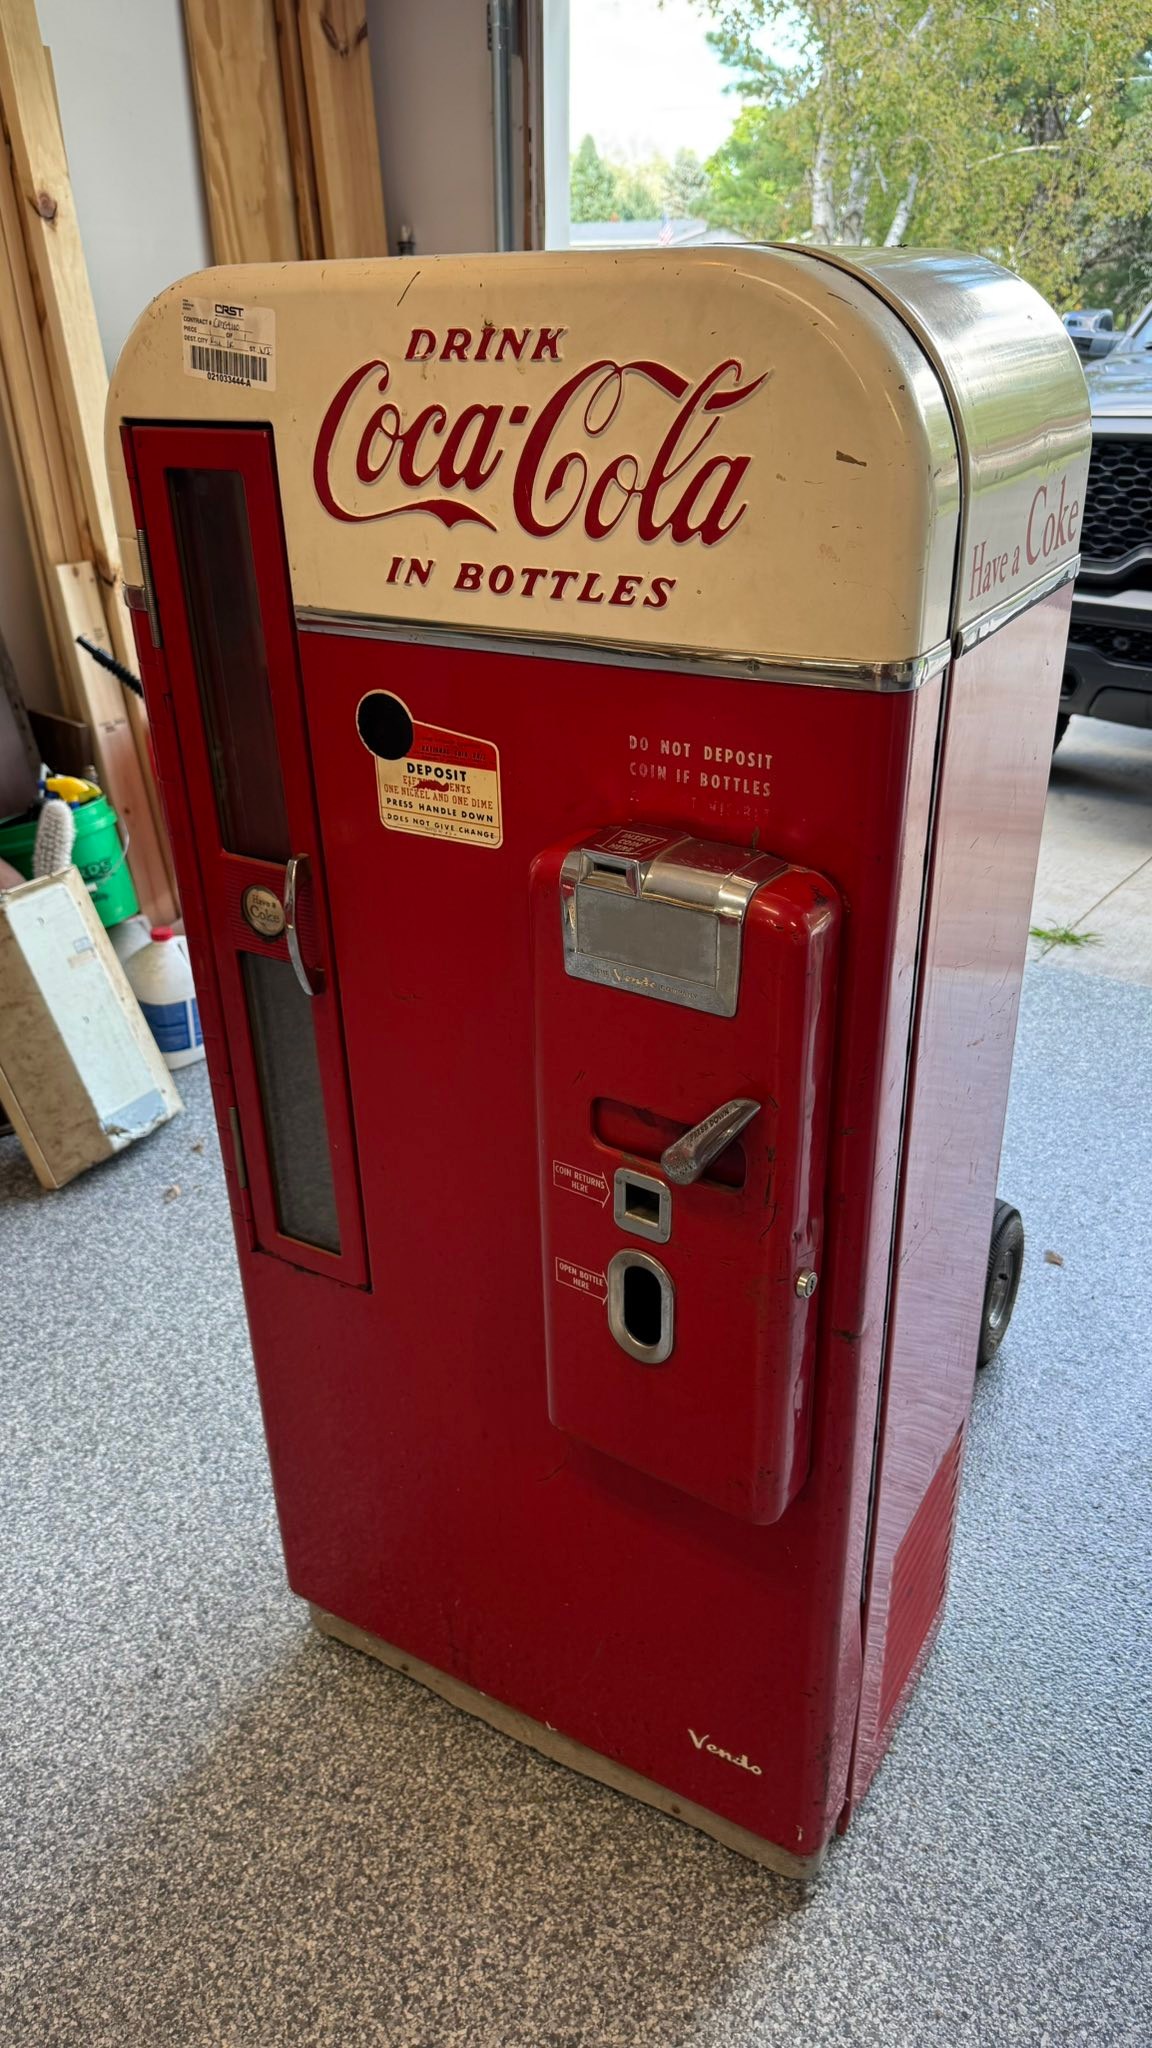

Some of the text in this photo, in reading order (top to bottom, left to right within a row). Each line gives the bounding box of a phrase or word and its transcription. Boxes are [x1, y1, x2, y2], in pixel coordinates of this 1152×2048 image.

[183, 316, 208, 326] CONTRACT
[214, 304, 244, 317] CRST
[183, 325, 198, 333] PIECE
[404, 327, 567, 362] DRINK
[312, 359, 776, 546] Coca-Cola
[969, 474, 1079, 601] Have a Coke
[386, 556, 678, 609] IN BOTTLES
[629, 735, 773, 770] DO NOT DEPOSIT
[406, 762, 467, 782] DEPOSIT
[629, 762, 771, 797] COIN IF BOTTLES
[383, 784, 494, 810] ONE NICKEL AND ONE DIME
[386, 797, 494, 823] PRESS HANDLE DOWN
[387, 813, 409, 823] DOES
[412, 818, 430, 827] NOT
[434, 822, 455, 831] GIVE
[458, 826, 495, 840] CHANGE
[555, 1165, 605, 1190] COIN RETURNS
[571, 1182, 589, 1194] HERE
[559, 1262, 604, 1287] OPEN BOTTLE
[572, 1277, 590, 1290] HERE
[687, 1728, 762, 1775] Vendo
